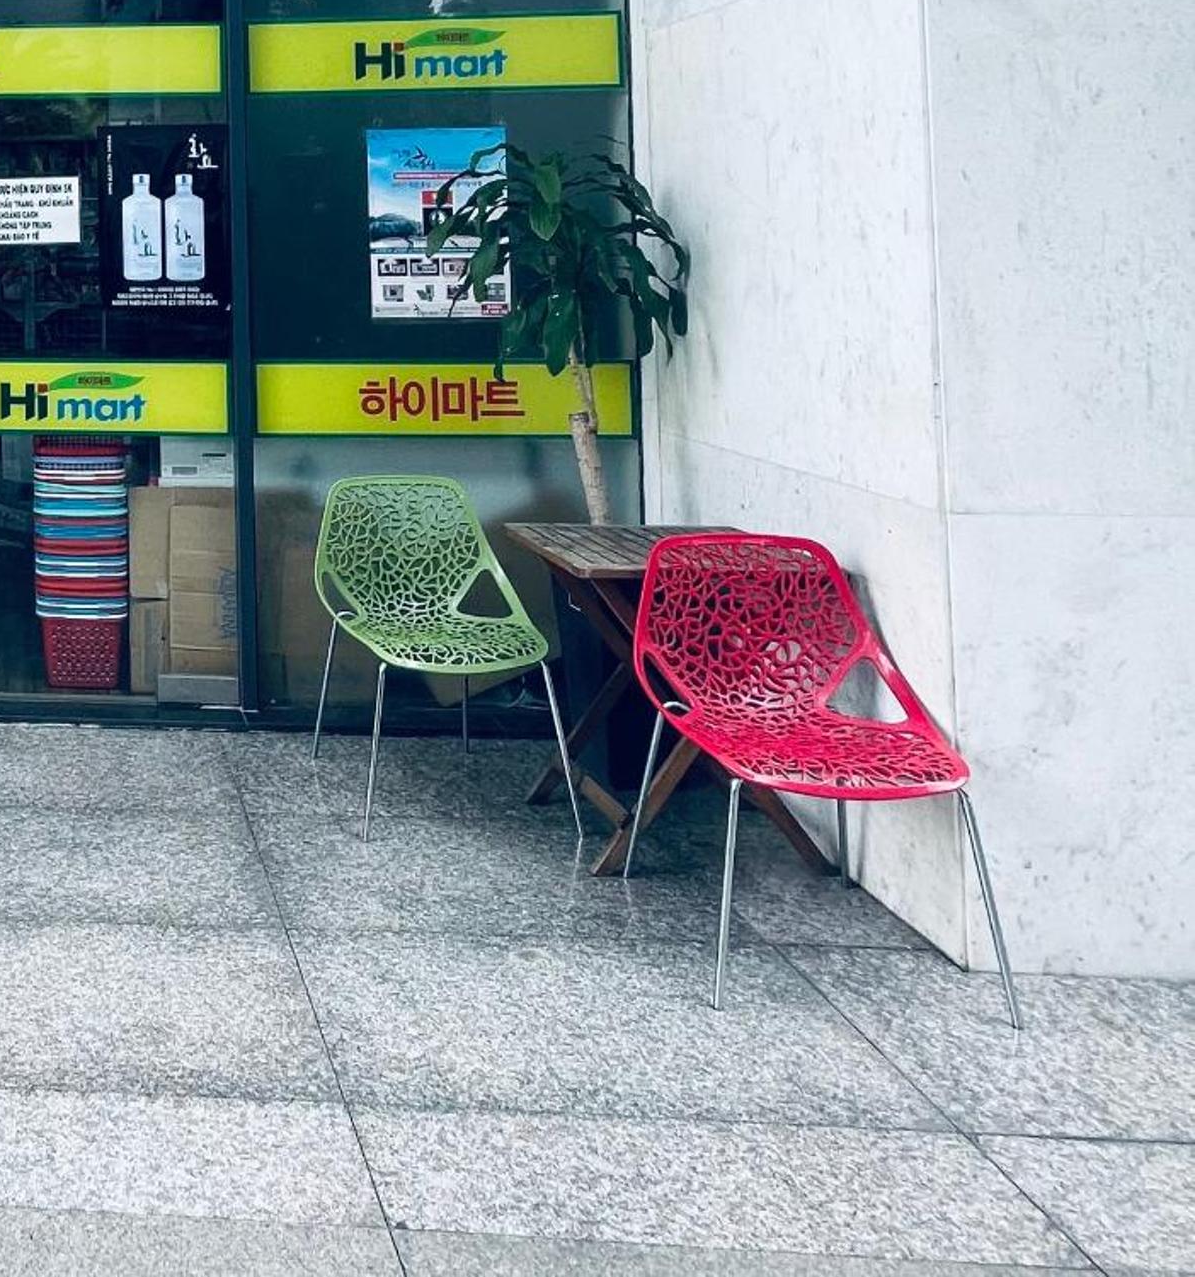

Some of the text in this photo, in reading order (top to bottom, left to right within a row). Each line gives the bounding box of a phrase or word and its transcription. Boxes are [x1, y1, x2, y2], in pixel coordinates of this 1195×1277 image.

[354, 42, 507, 81] Hi mart
[0, 381, 146, 421] Hi mart
[358, 376, 525, 422] 하이마트
